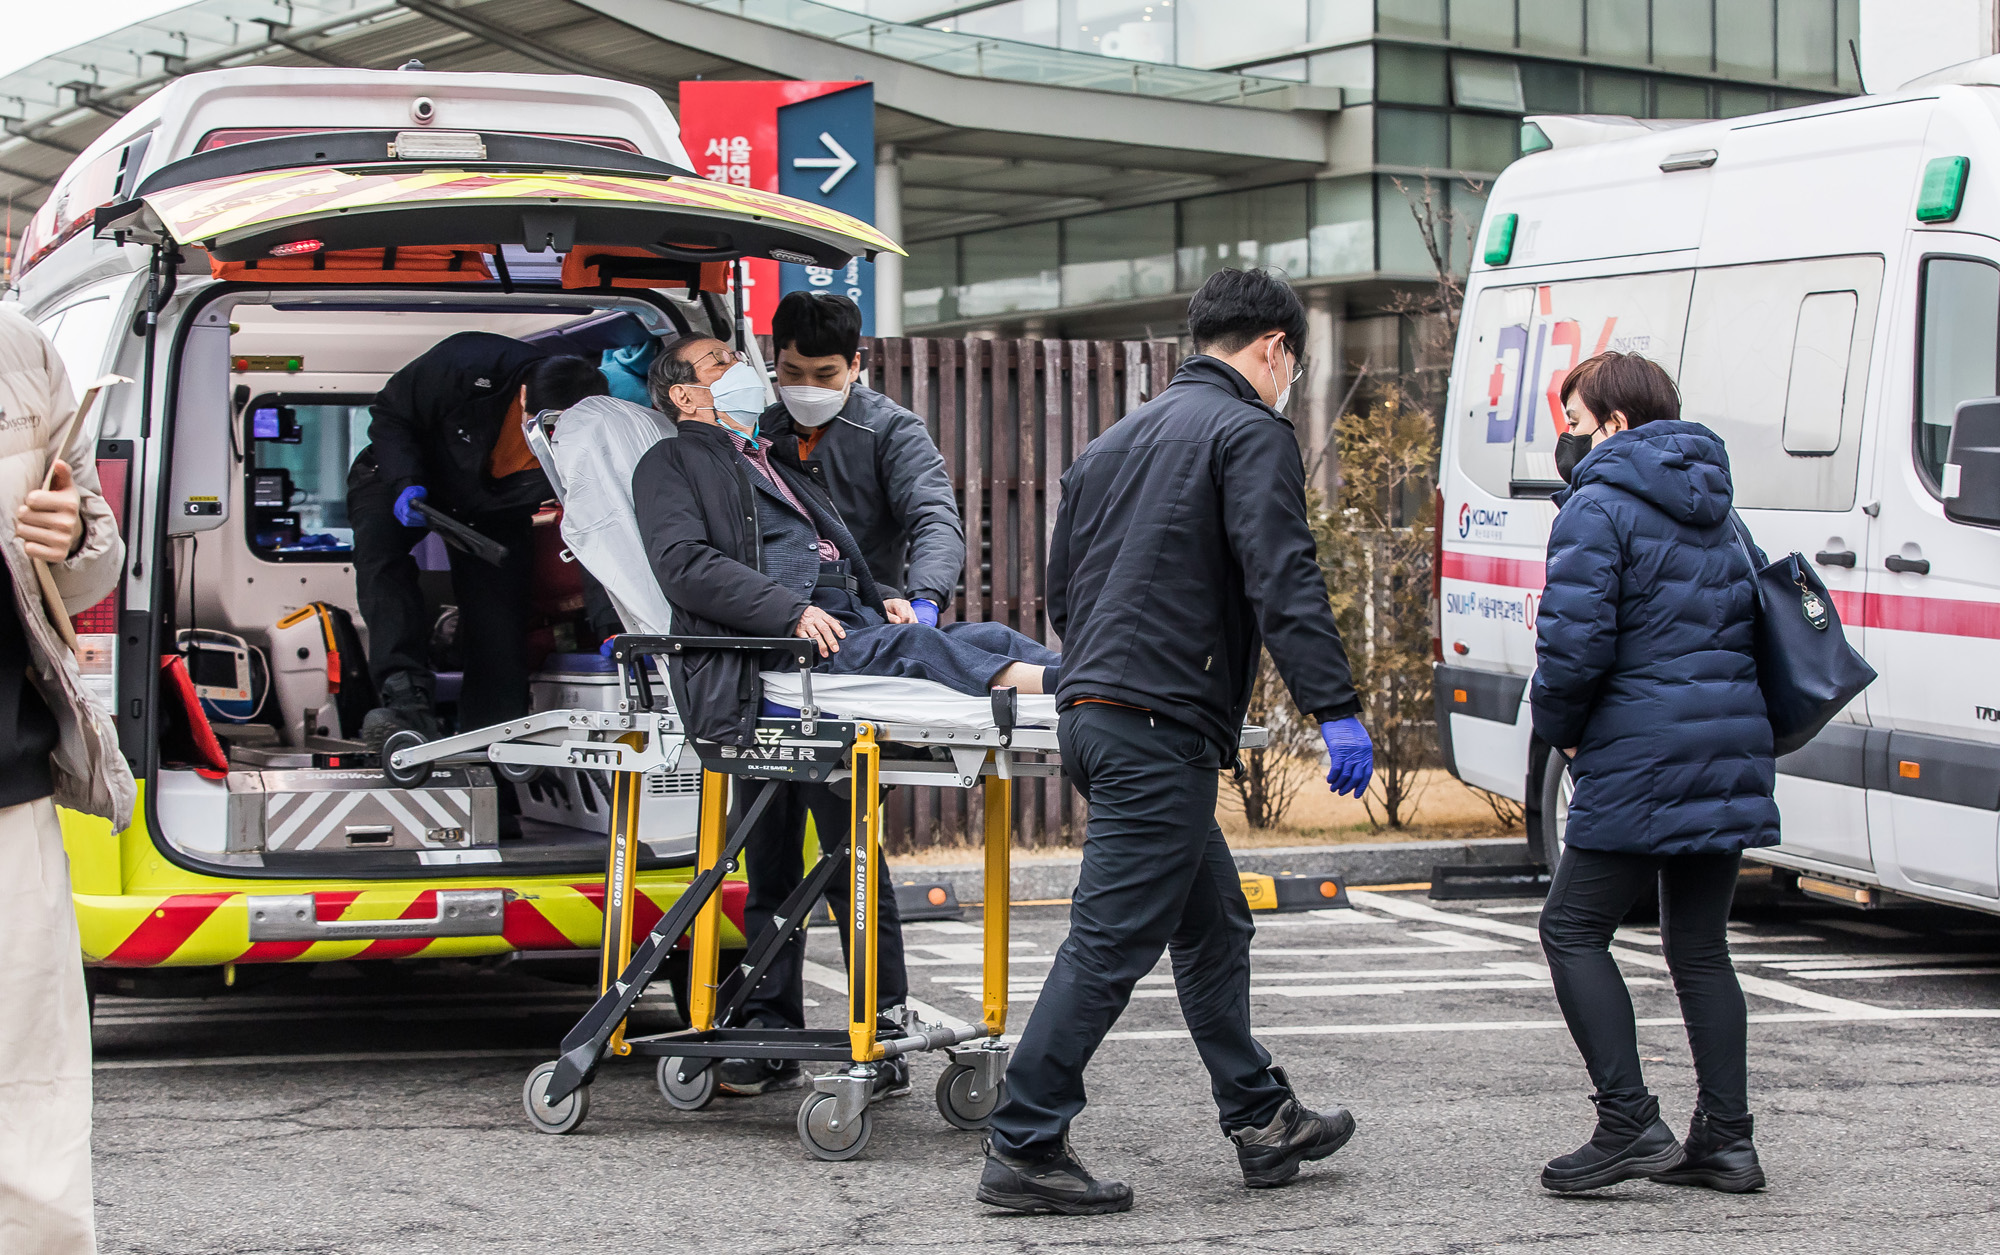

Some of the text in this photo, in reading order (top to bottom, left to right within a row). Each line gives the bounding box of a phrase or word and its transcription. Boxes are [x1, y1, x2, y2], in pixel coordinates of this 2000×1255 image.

[704, 136, 752, 164] 서울
[720, 746, 817, 761] SAVER
[613, 849, 625, 907] SUNGWOO
[856, 864, 866, 931] SUNGWOO
